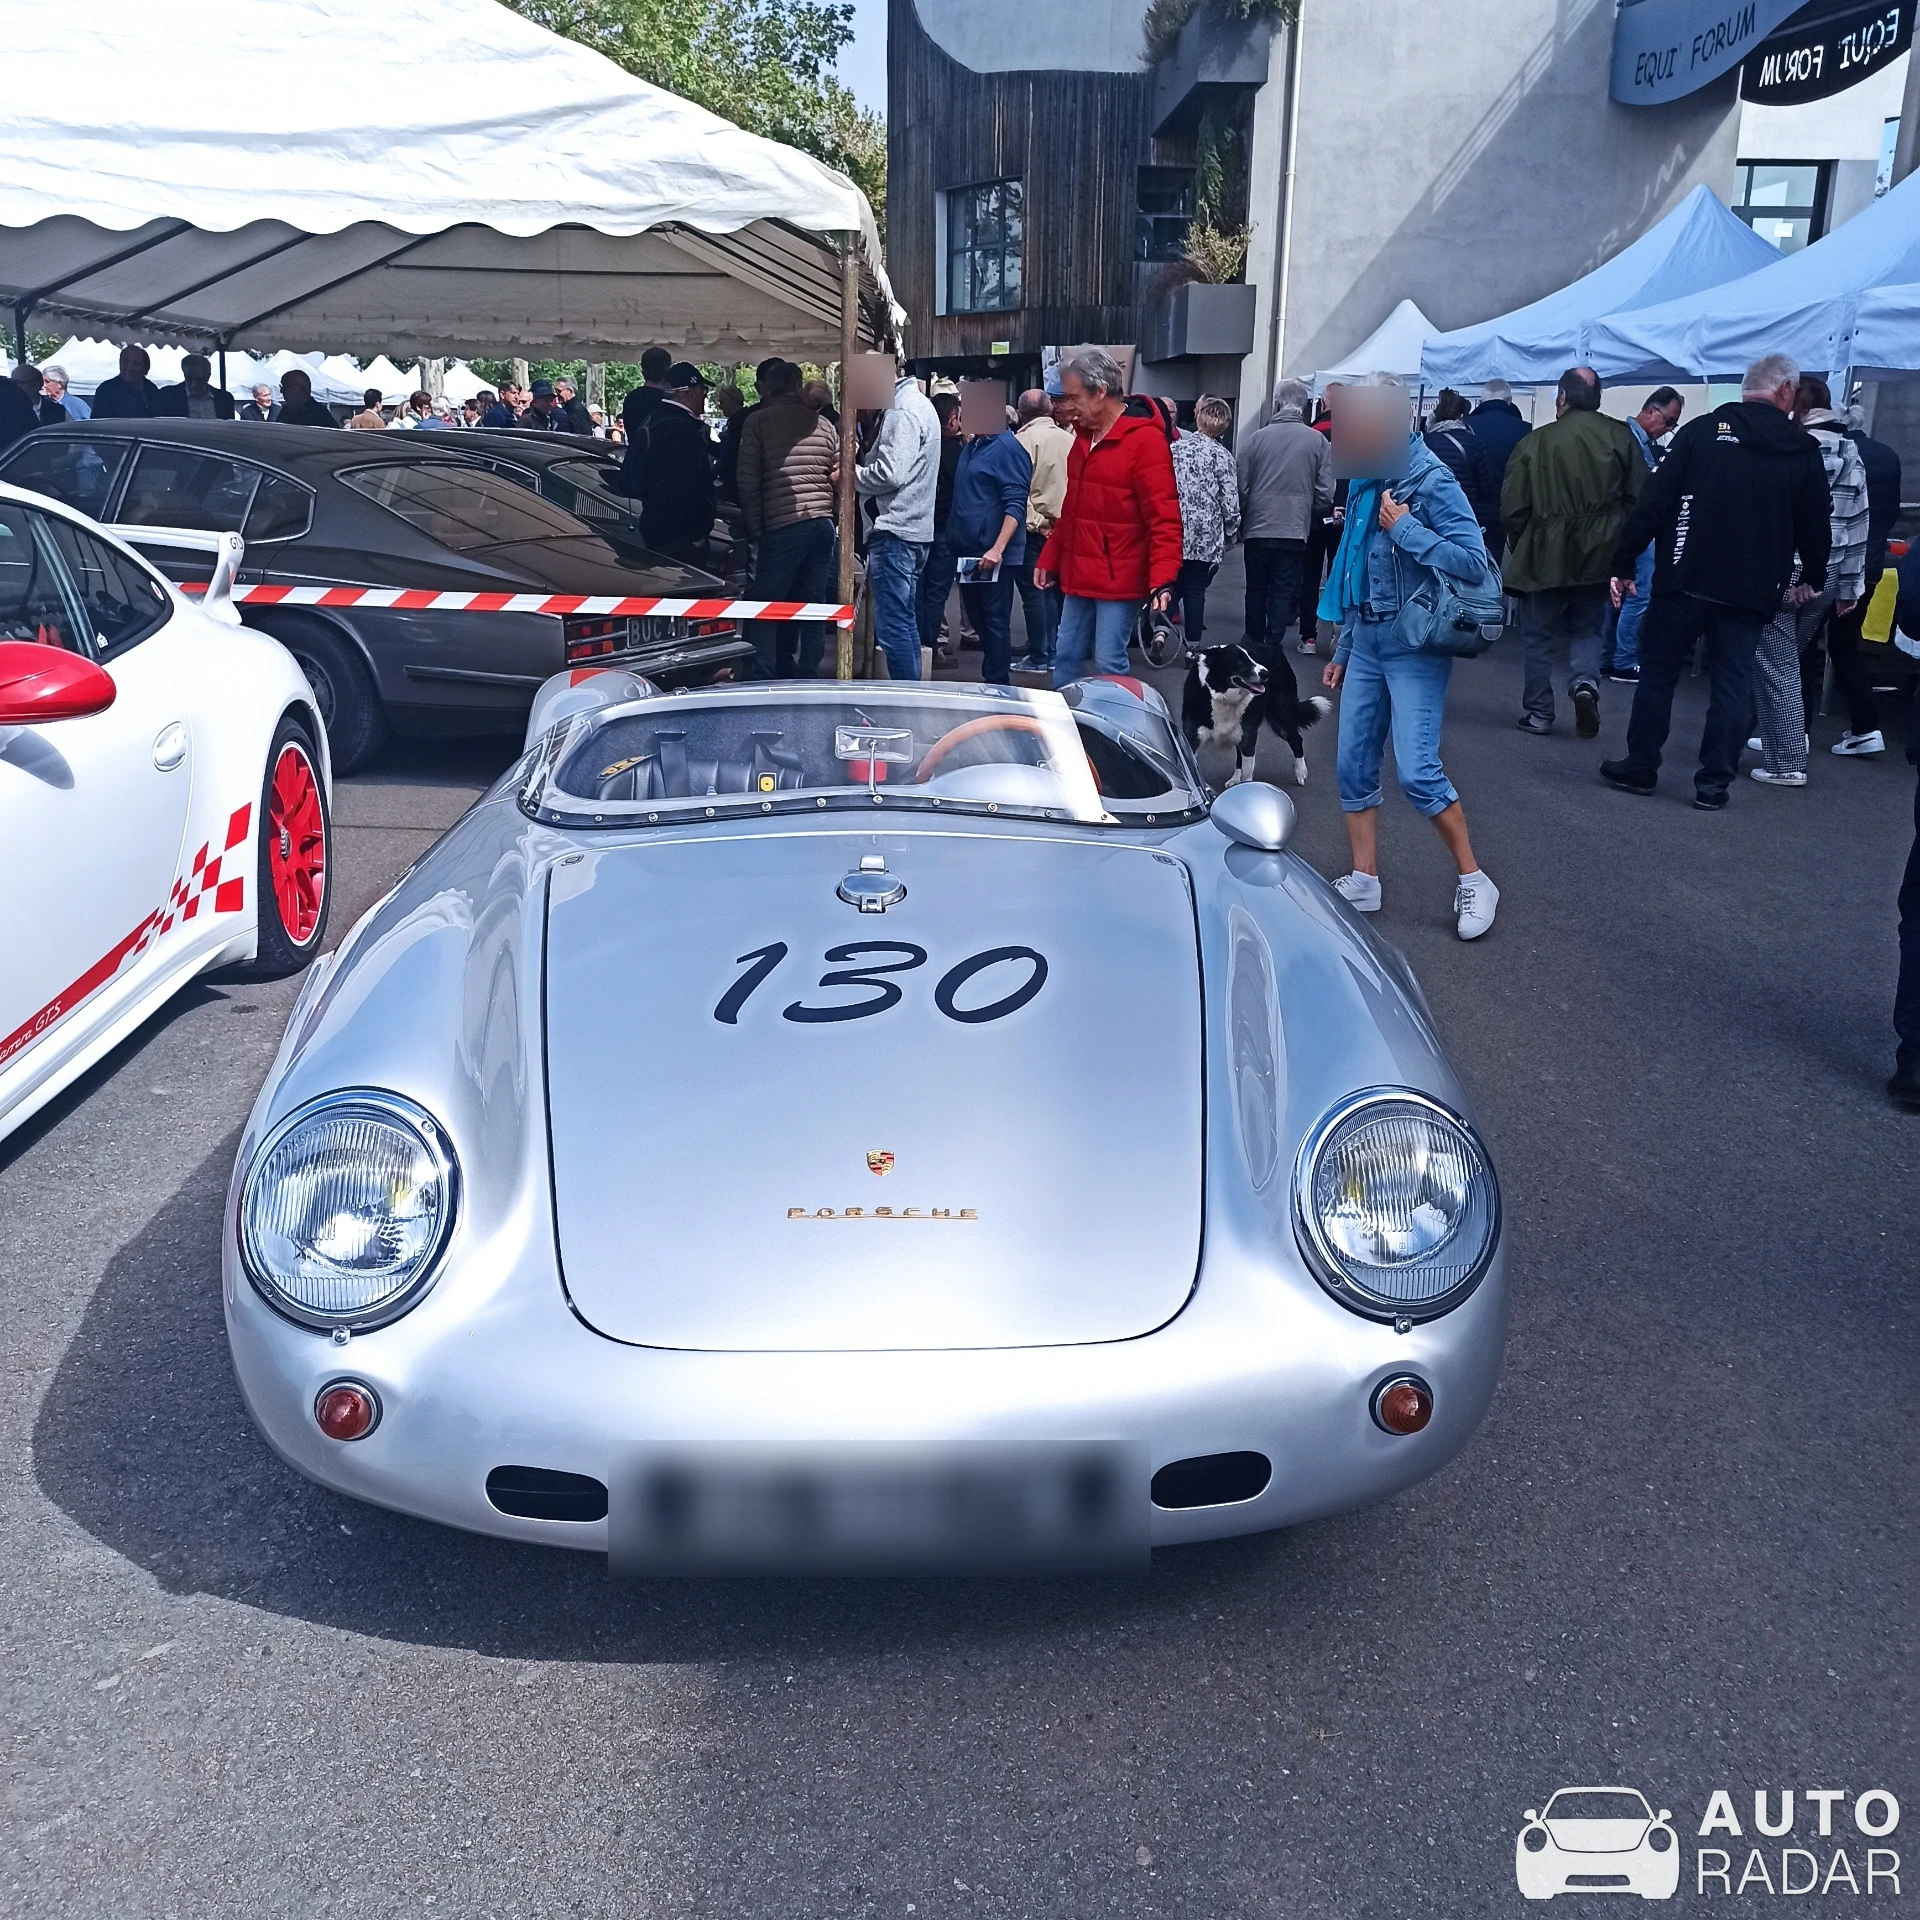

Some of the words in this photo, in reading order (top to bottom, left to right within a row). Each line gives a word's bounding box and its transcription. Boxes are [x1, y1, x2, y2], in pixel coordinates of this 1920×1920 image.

[1690, 1, 1755, 71] FORUM
[229, 536, 244, 550] GTS
[630, 617, 662, 646] BUC
[713, 940, 1049, 1025] 130
[0, 1029, 33, 1060] arrera
[35, 1000, 62, 1032] GTS
[787, 1206, 980, 1220] PORSCHE
